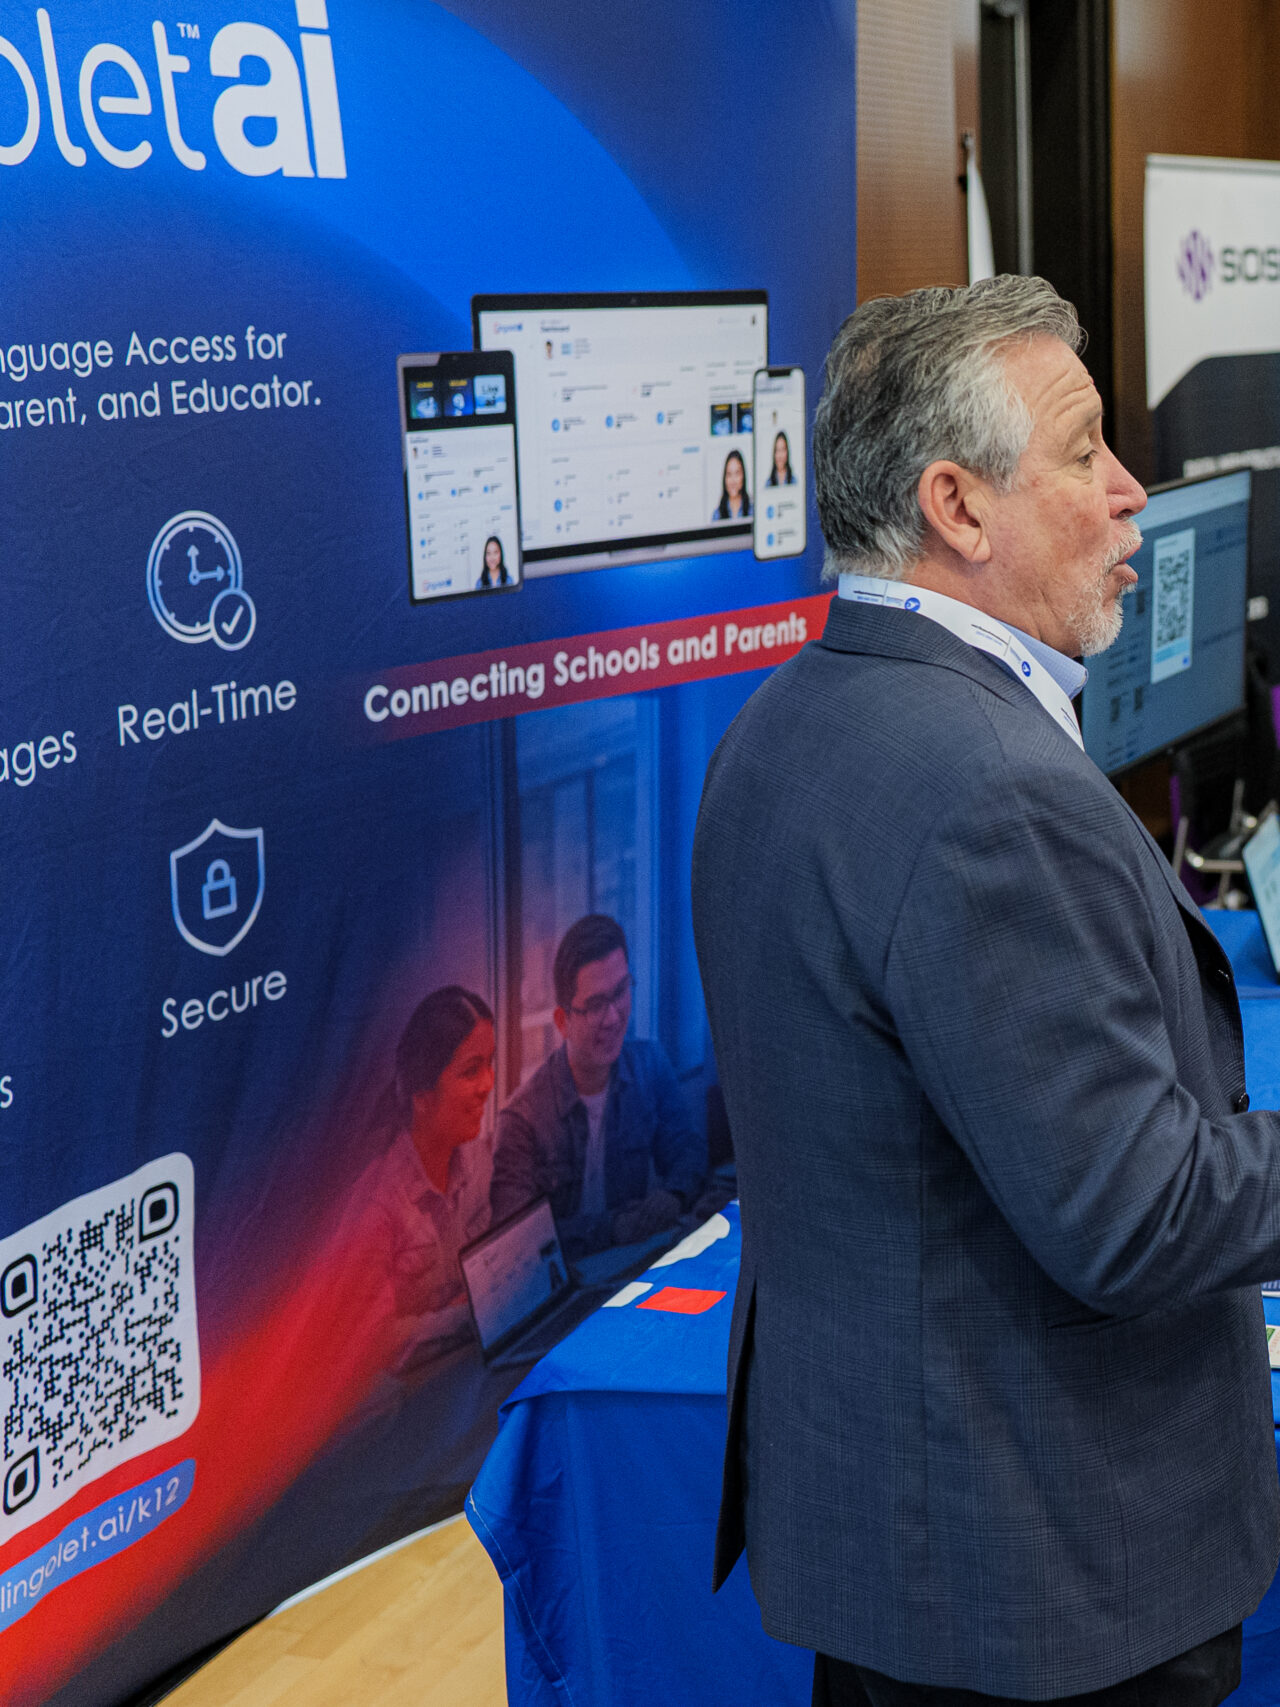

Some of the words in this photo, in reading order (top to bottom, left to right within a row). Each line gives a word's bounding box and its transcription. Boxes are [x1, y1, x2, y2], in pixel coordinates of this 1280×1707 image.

[125, 331, 237, 366] Access
[244, 324, 287, 361] for
[98, 381, 162, 420] and
[171, 374, 321, 414] Educator.
[364, 659, 546, 722] Connecting
[553, 637, 660, 687] Schools
[666, 625, 718, 665] and
[723, 612, 808, 656] Parents
[117, 680, 297, 746] Real-Time
[160, 970, 288, 1039] Secure
[0, 1476, 180, 1613] lingolet.ai/k12
